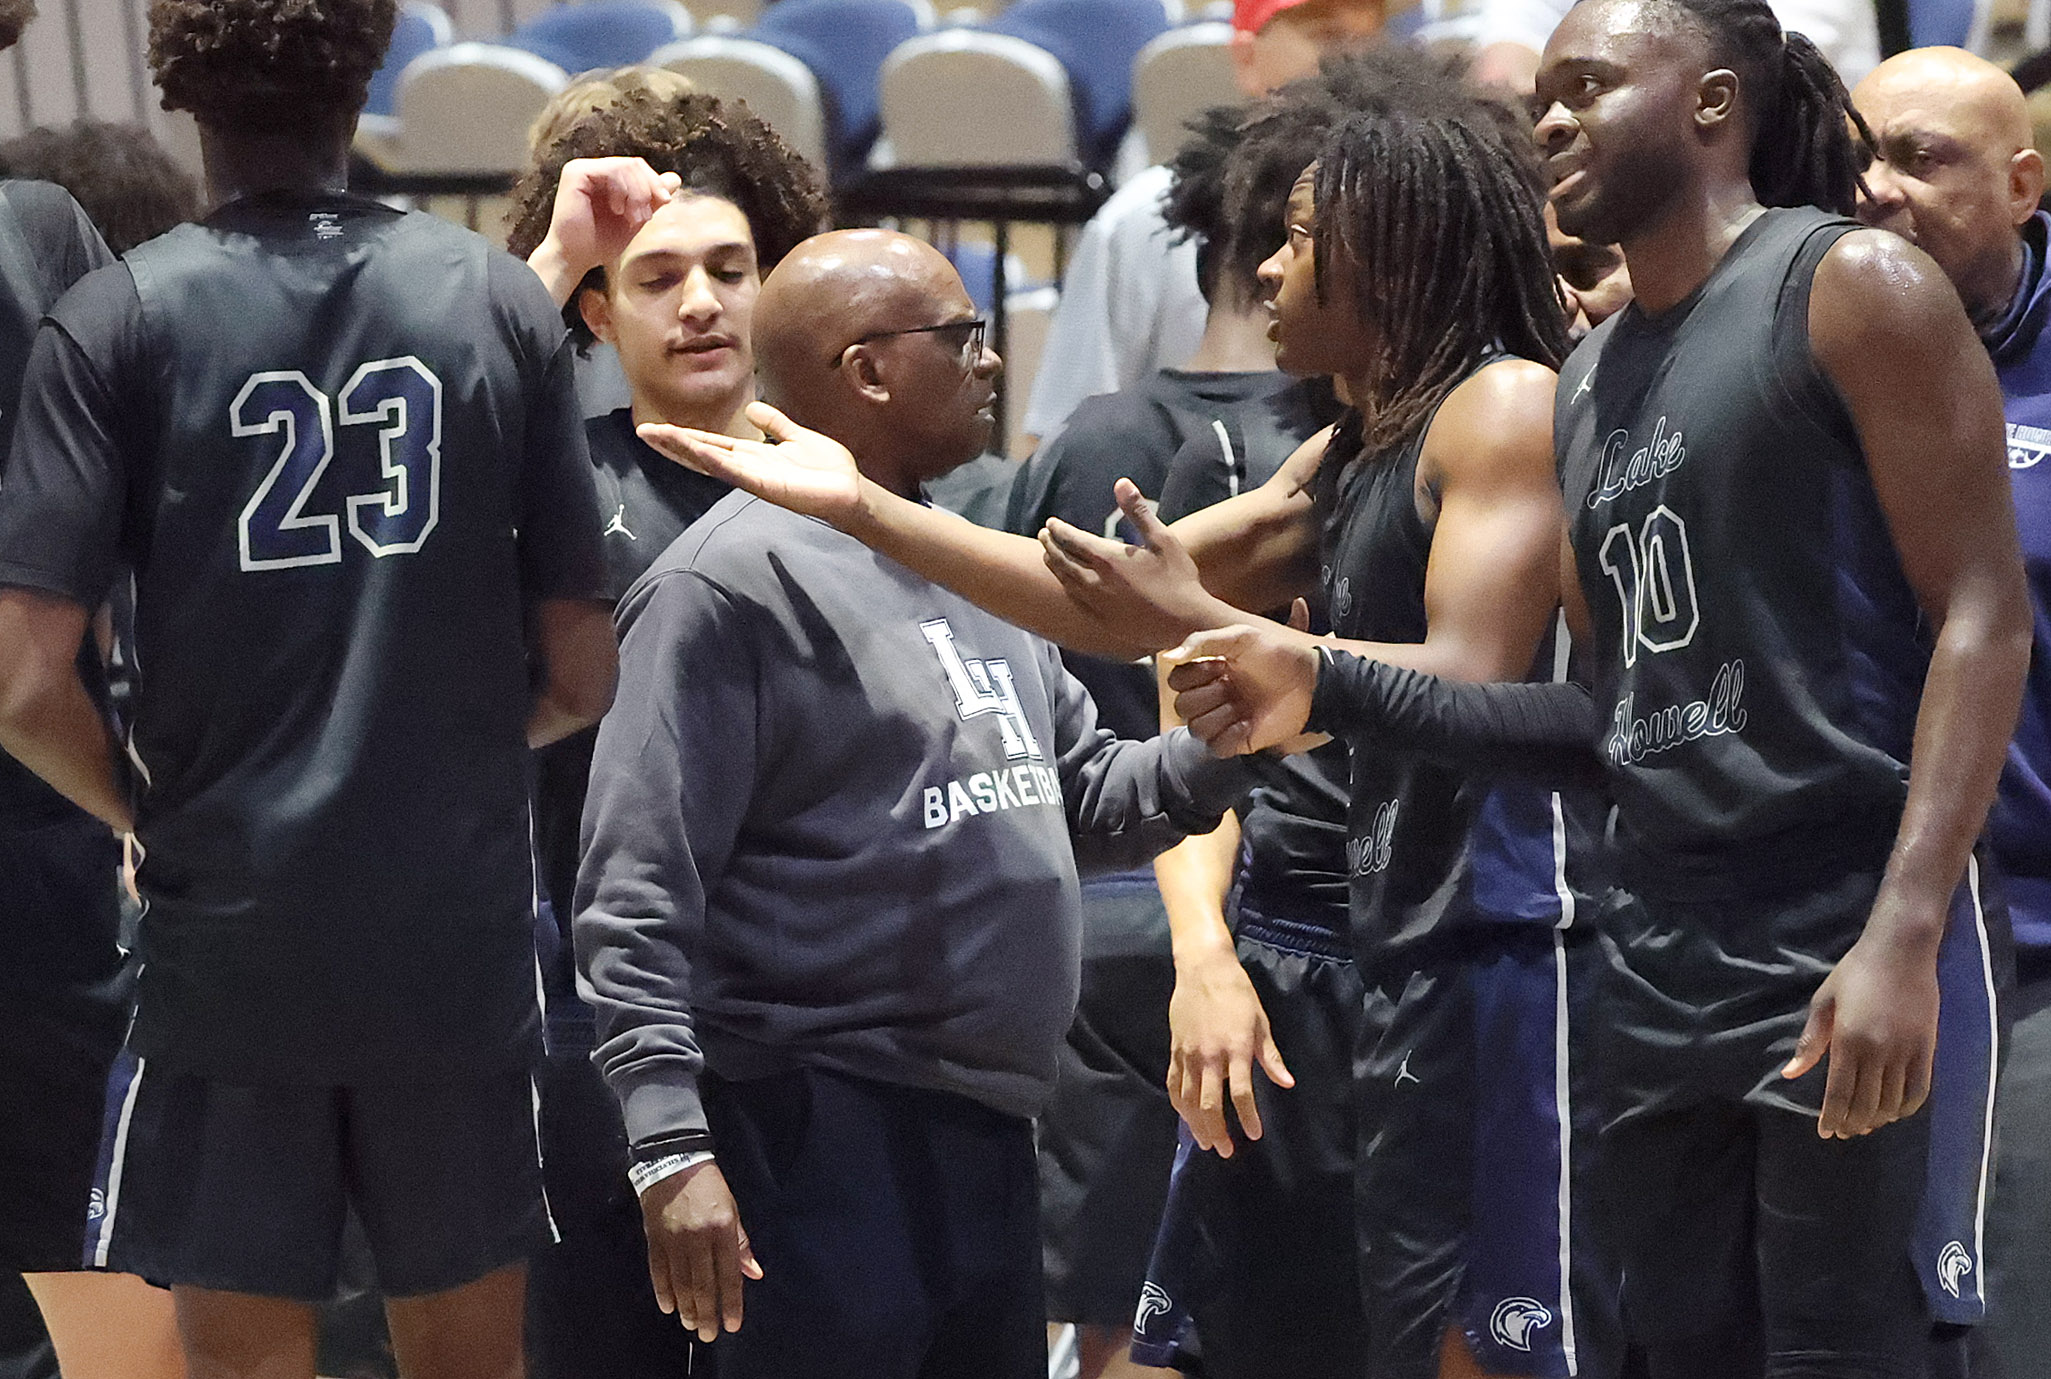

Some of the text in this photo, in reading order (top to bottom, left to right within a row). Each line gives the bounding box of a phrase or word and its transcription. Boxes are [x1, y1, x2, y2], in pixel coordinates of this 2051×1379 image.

[229, 355, 443, 573] 23
[1587, 416, 1685, 509] Lake
[1599, 504, 1699, 669] 10
[919, 616, 1044, 761] LH
[1608, 659, 1748, 768] Howell
